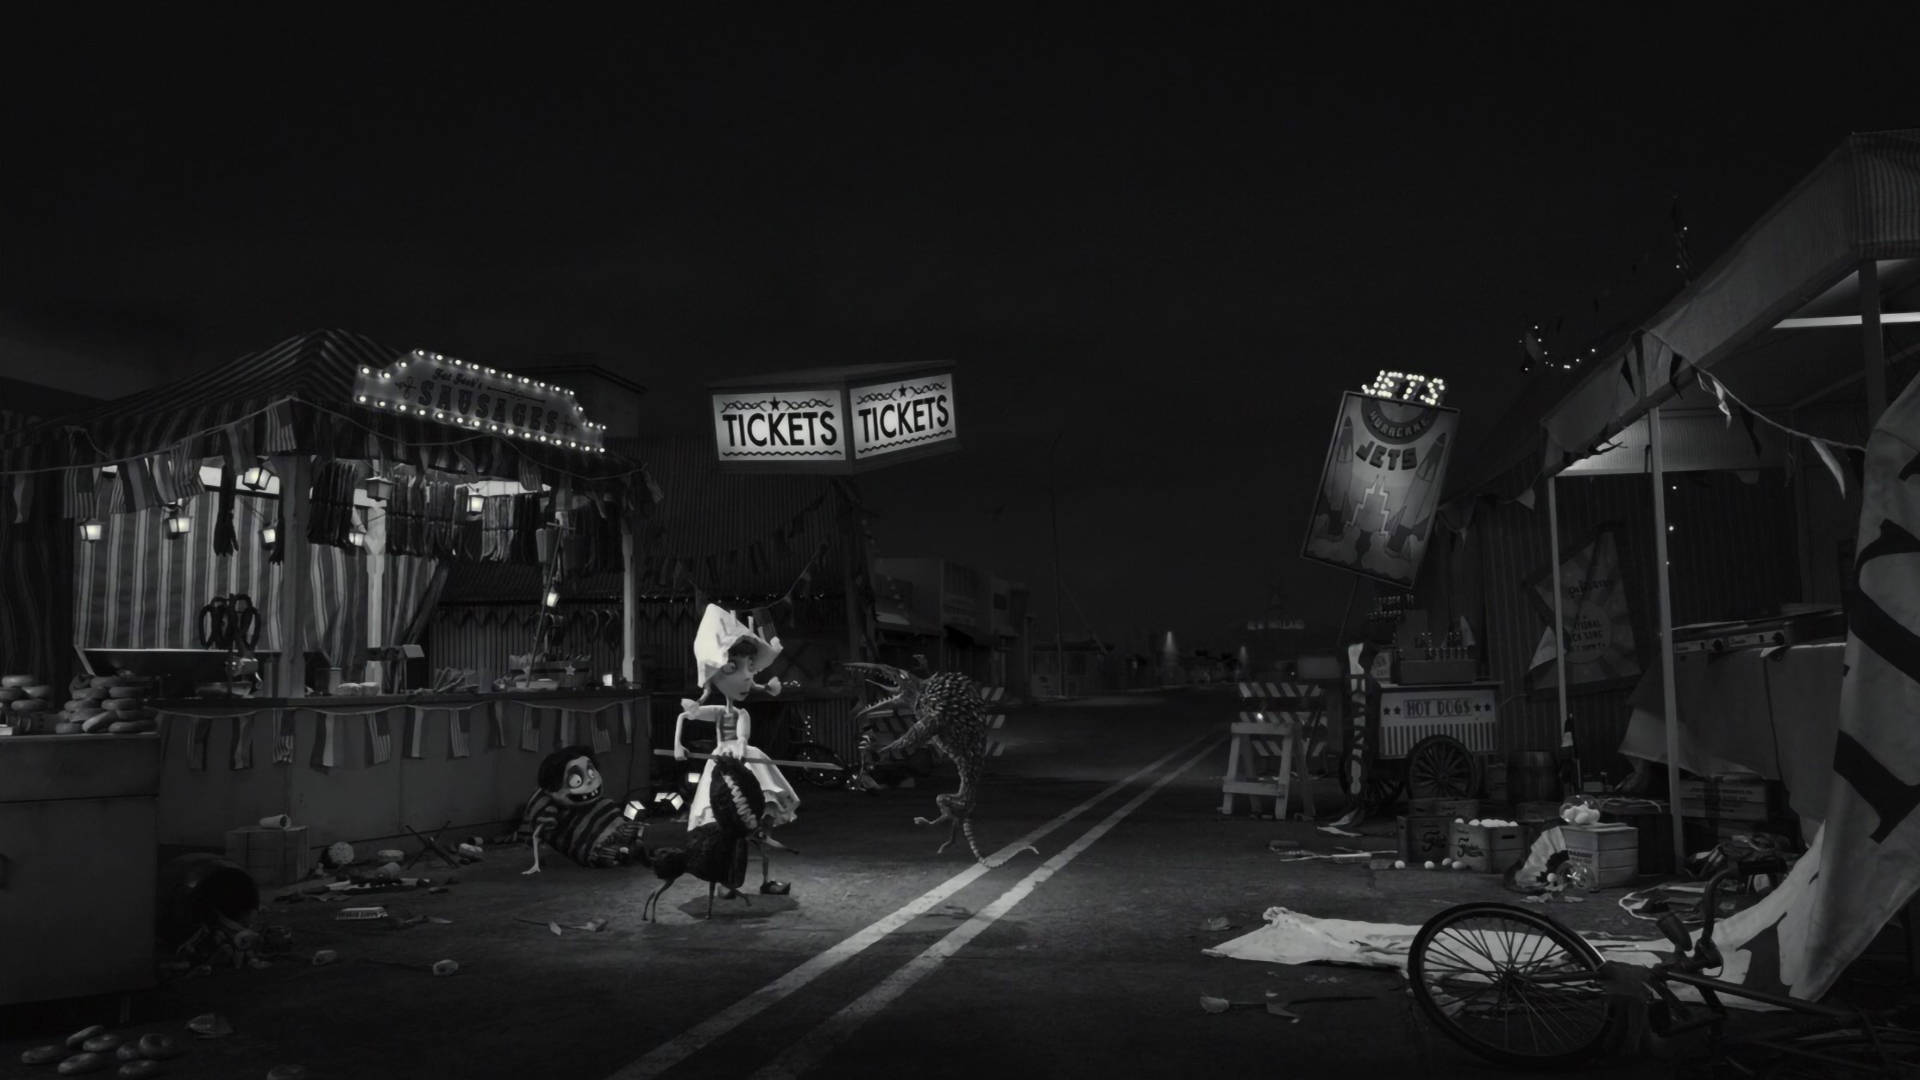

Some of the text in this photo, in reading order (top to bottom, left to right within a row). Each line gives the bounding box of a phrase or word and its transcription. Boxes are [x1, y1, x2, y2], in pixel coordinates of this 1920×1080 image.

[1361, 370, 1445, 405] JETS
[418, 380, 559, 434] SAUSAGES
[858, 395, 950, 443] TICKETS
[722, 411, 838, 446] TICKETS
[1356, 441, 1417, 471] JETS
[1407, 699, 1470, 716] HOT DOGS
